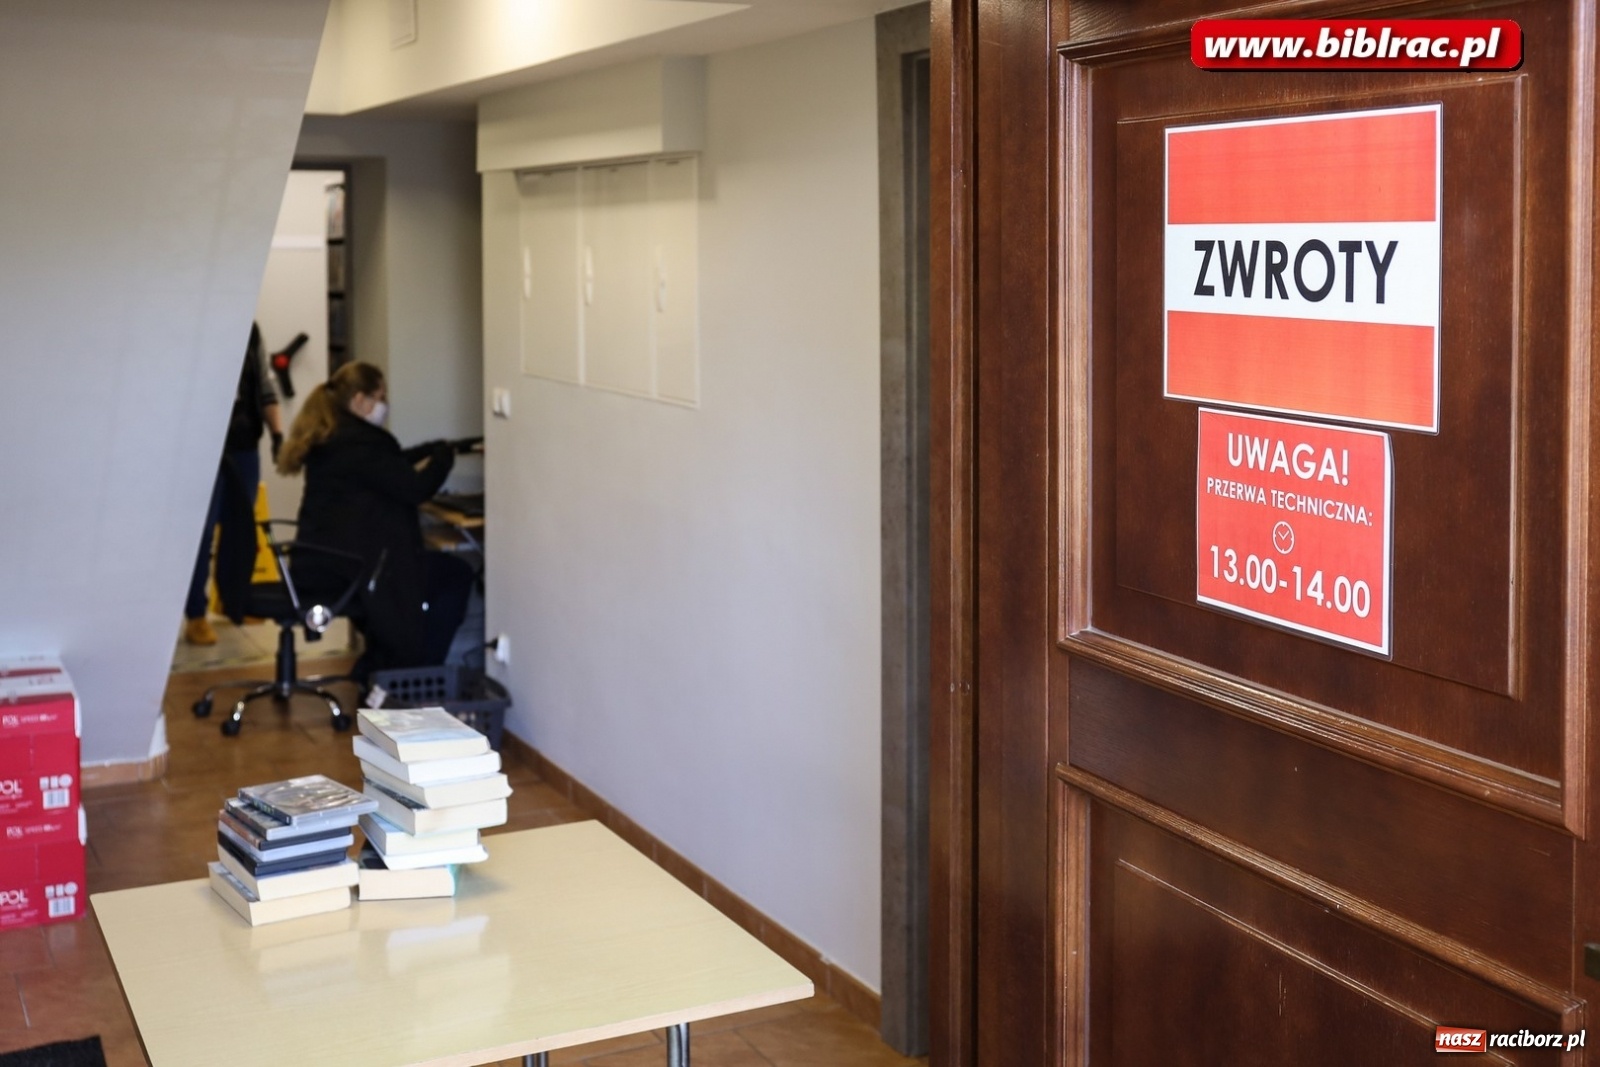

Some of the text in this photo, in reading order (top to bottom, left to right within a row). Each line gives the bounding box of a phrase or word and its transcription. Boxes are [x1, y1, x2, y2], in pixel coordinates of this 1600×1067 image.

[1193, 238, 1399, 305] ZWROTY
[1227, 432, 1349, 487] UWAGA!
[1206, 476, 1374, 527] PRZERWA TECHNICZNA:
[1210, 544, 1371, 618] 13.00-14.00
